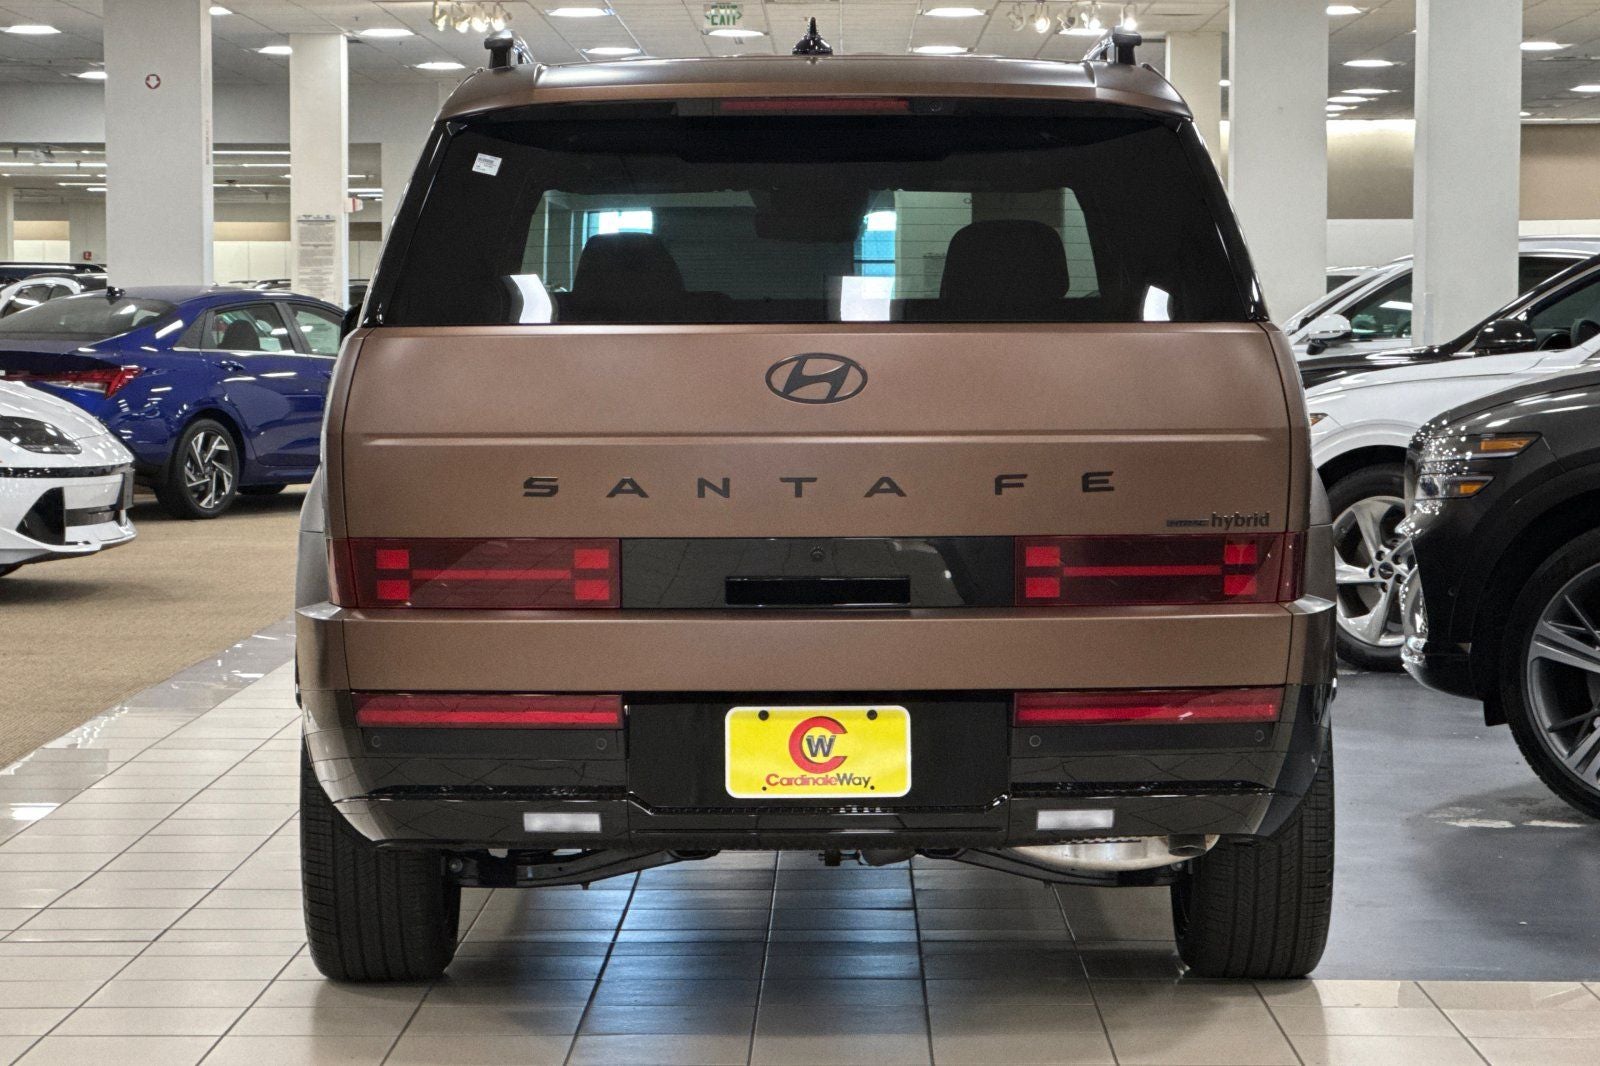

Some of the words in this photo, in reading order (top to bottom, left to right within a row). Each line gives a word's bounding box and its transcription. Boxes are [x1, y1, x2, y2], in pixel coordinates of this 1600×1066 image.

[523, 476, 908, 498] SANTA
[994, 471, 1115, 496] FE
[1211, 511, 1270, 531] hybrid
[765, 772, 871, 789] CardinaleWay
